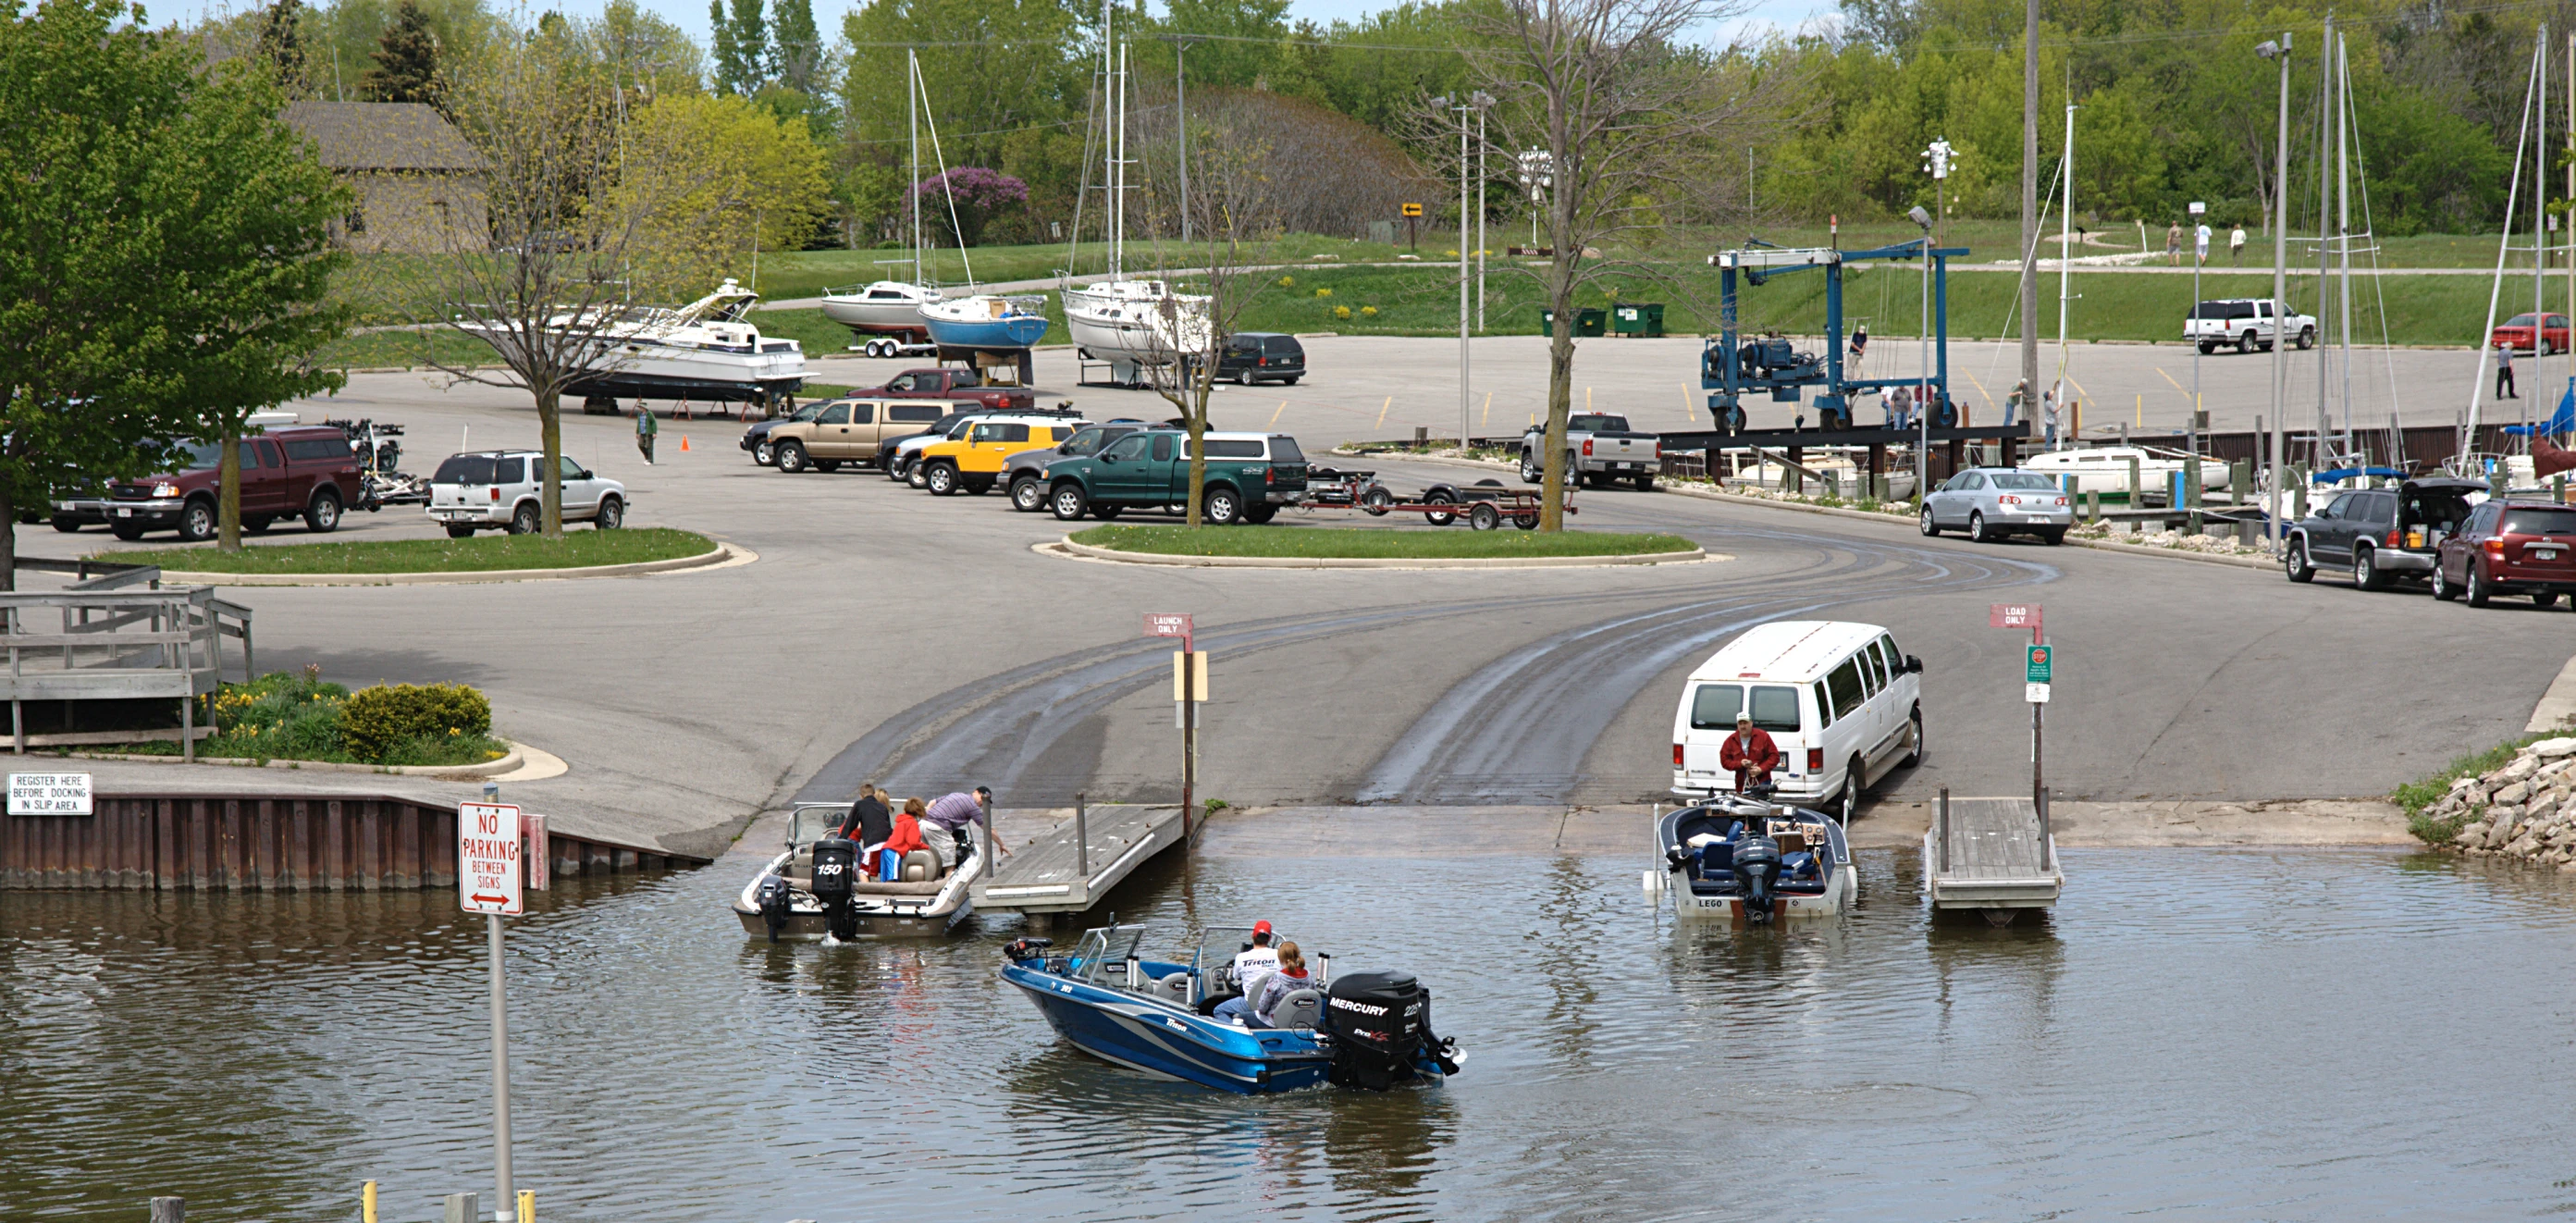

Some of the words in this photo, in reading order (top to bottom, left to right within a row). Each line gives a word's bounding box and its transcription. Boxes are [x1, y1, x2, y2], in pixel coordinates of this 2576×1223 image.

[2005, 607, 2026, 615] LOAD
[1153, 616, 1182, 624] LAUNCH
[2005, 615, 2025, 624] ONLY
[1158, 624, 1177, 633] ONLY
[17, 776, 55, 785] REGISTER
[61, 776, 82, 785] HERE
[13, 788, 44, 797] BEFORE
[51, 788, 86, 797] DOCKING
[22, 800, 30, 809] IN
[34, 800, 53, 809] SLIP
[55, 801, 78, 810] AREA
[478, 814, 498, 834] NO
[463, 838, 515, 860] PARKING
[473, 860, 506, 874] BETWEEN
[818, 864, 843, 875] 150
[478, 876, 500, 889] SIGNS
[1242, 958, 1276, 967] Triton
[1329, 997, 1388, 1016] MERCURY
[1404, 1004, 1418, 1017] 225
[1166, 1018, 1188, 1032] Triton
